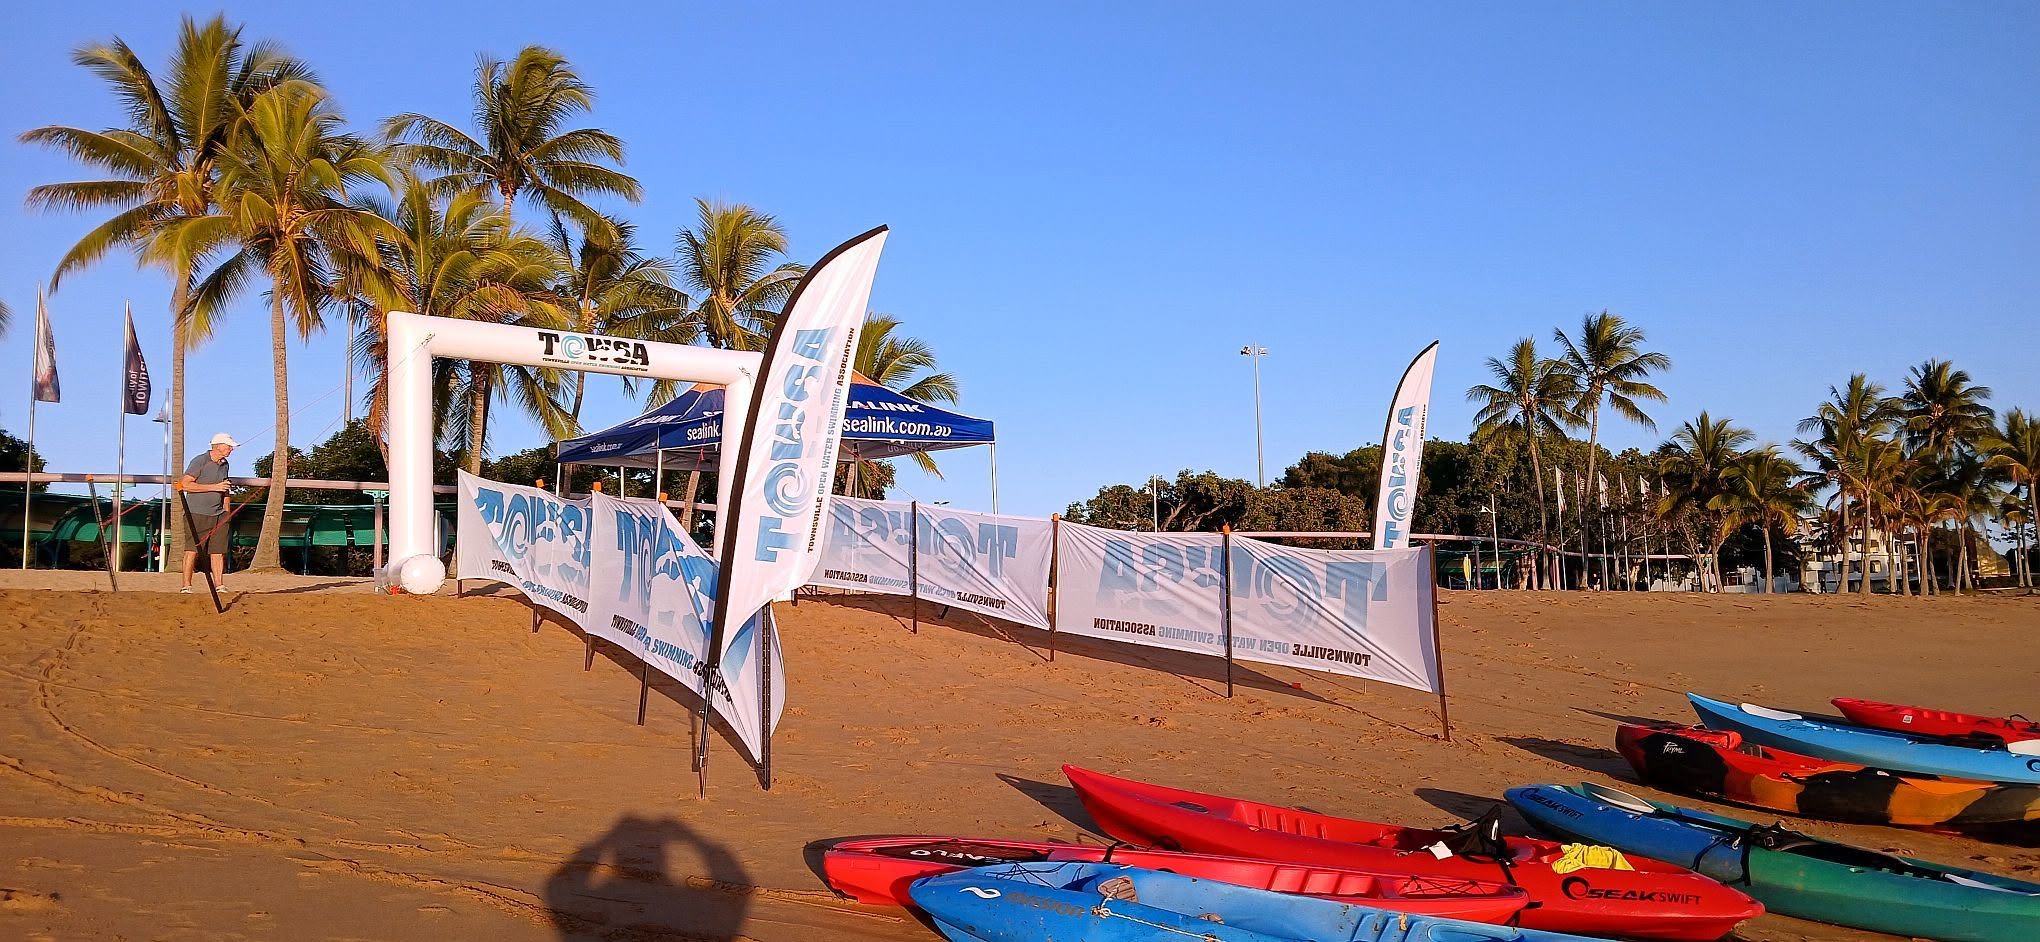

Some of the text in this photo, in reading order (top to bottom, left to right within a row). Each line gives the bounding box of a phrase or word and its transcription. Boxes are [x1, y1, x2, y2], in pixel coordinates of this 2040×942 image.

[538, 332, 649, 366] TOWSA
[808, 328, 854, 553] TOWNSVILLE OPEN WATER SWIMMING ASSOCIATION
[843, 416, 952, 437] sealink.com.au
[755, 327, 838, 562] TOWSA
[651, 639, 694, 669] SWIMMING
